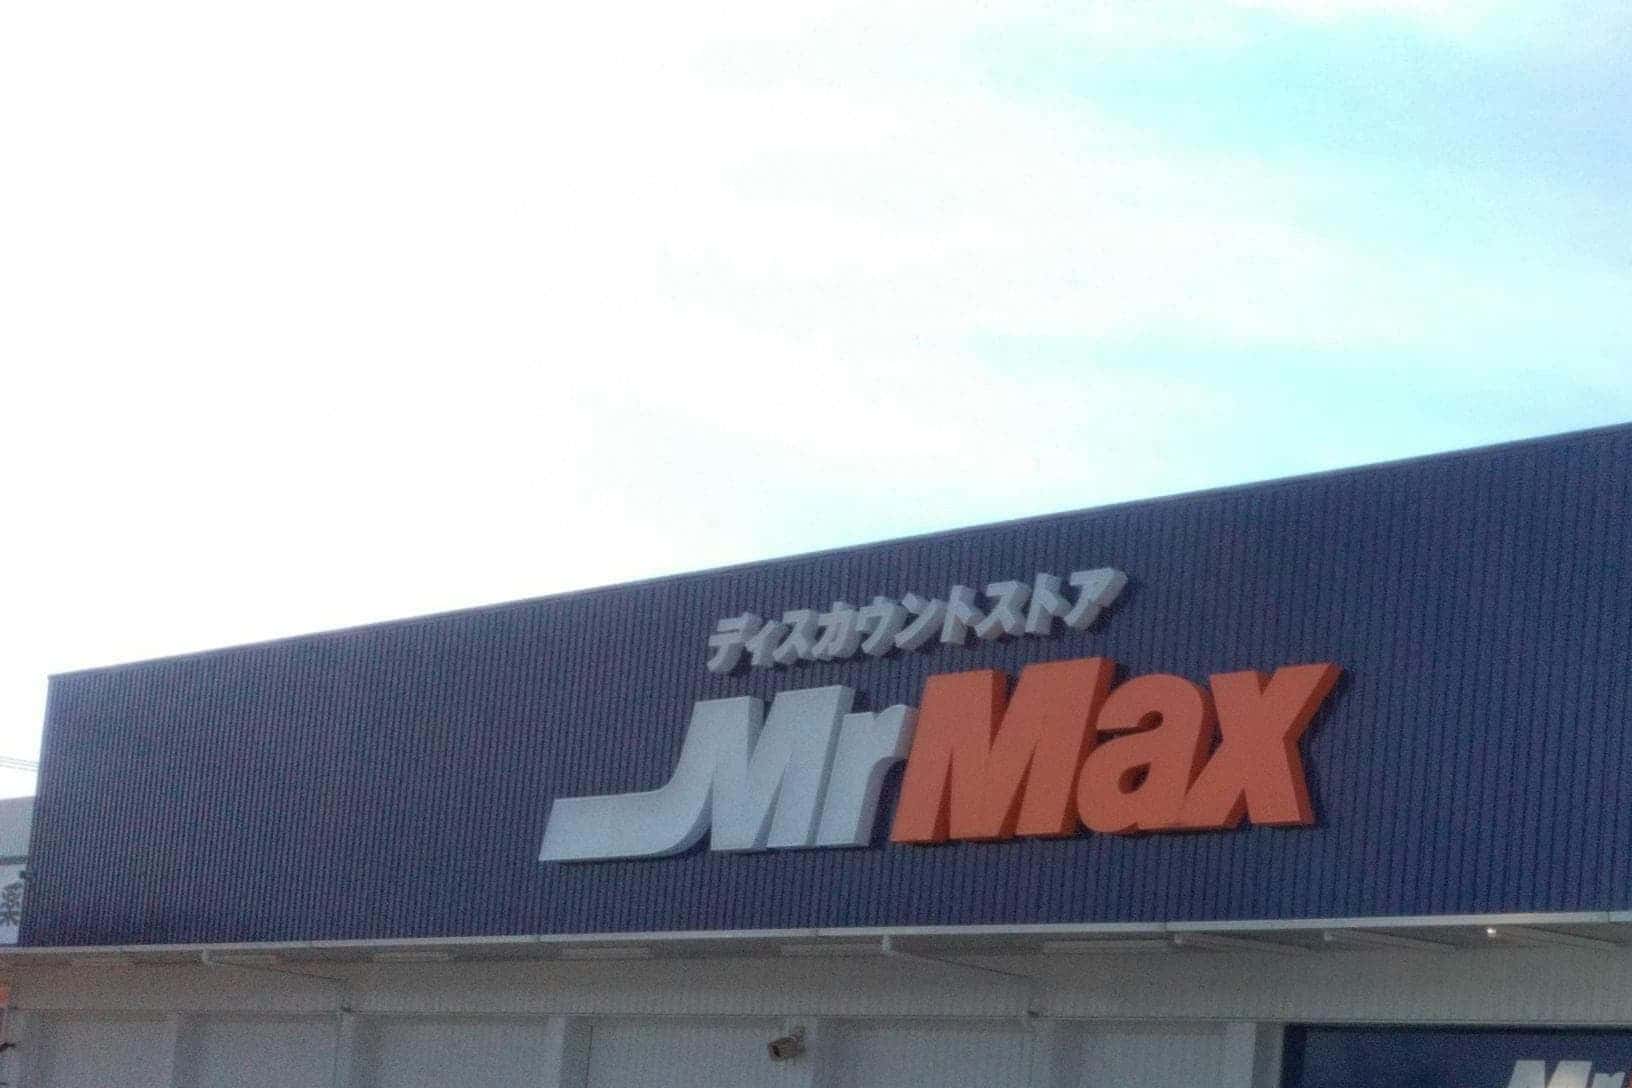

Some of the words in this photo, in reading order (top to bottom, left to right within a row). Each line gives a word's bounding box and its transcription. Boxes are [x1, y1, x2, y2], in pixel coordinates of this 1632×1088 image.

[707, 566, 1127, 674] ディスカウントストア
[538, 656, 1344, 863] MrMax
